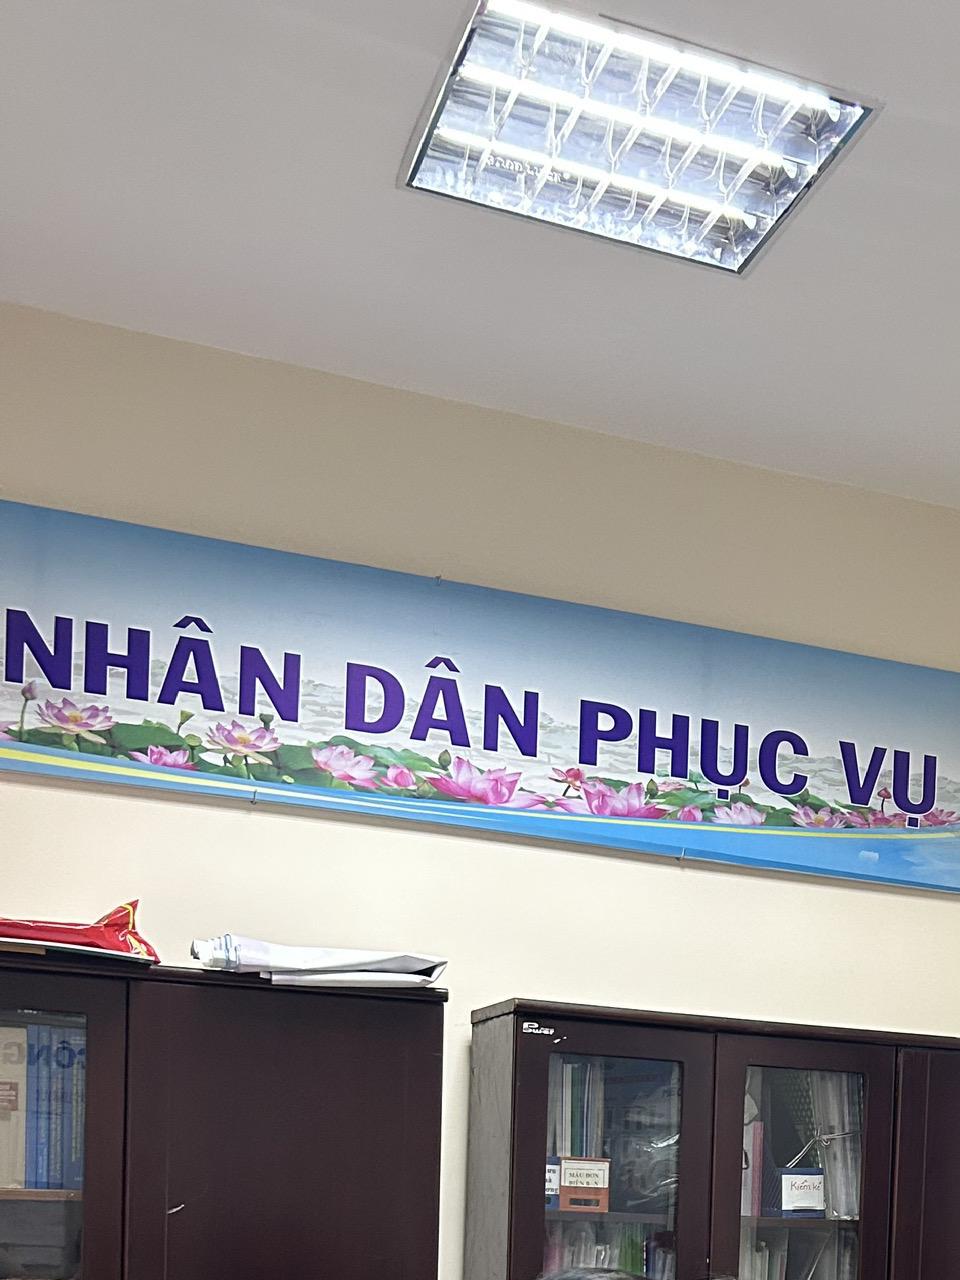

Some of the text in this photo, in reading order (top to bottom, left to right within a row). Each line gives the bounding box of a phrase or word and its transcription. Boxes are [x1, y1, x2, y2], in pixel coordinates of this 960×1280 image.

[3, 609, 938, 828] NHÂN DÂN PHỤC VỤ
